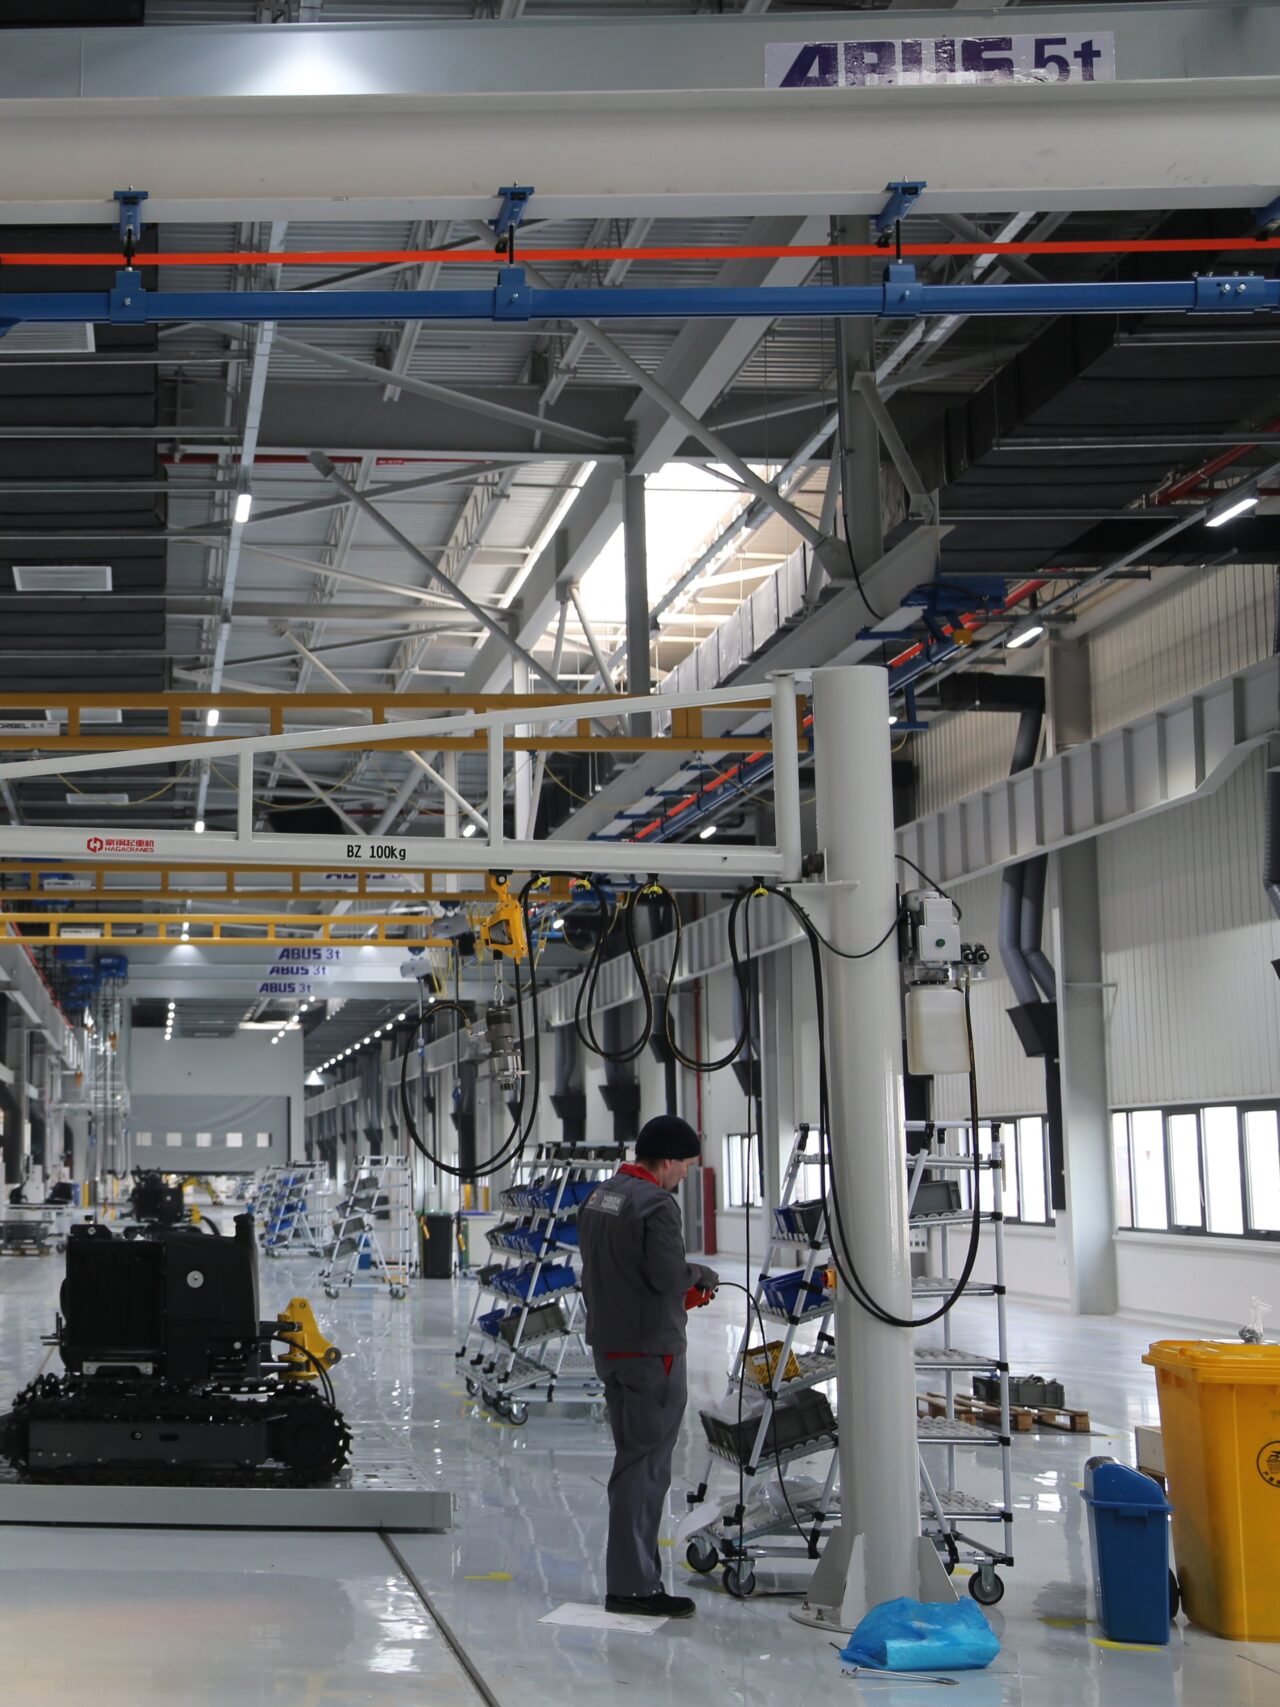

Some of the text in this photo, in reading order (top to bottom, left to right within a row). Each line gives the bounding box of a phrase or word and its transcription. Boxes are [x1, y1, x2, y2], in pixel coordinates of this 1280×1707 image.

[346, 844, 407, 861] BZ 100kg
[278, 947, 341, 960] ABUS 3t
[268, 966, 327, 976] ABUS 3t
[259, 982, 312, 993] ABUS 3t
